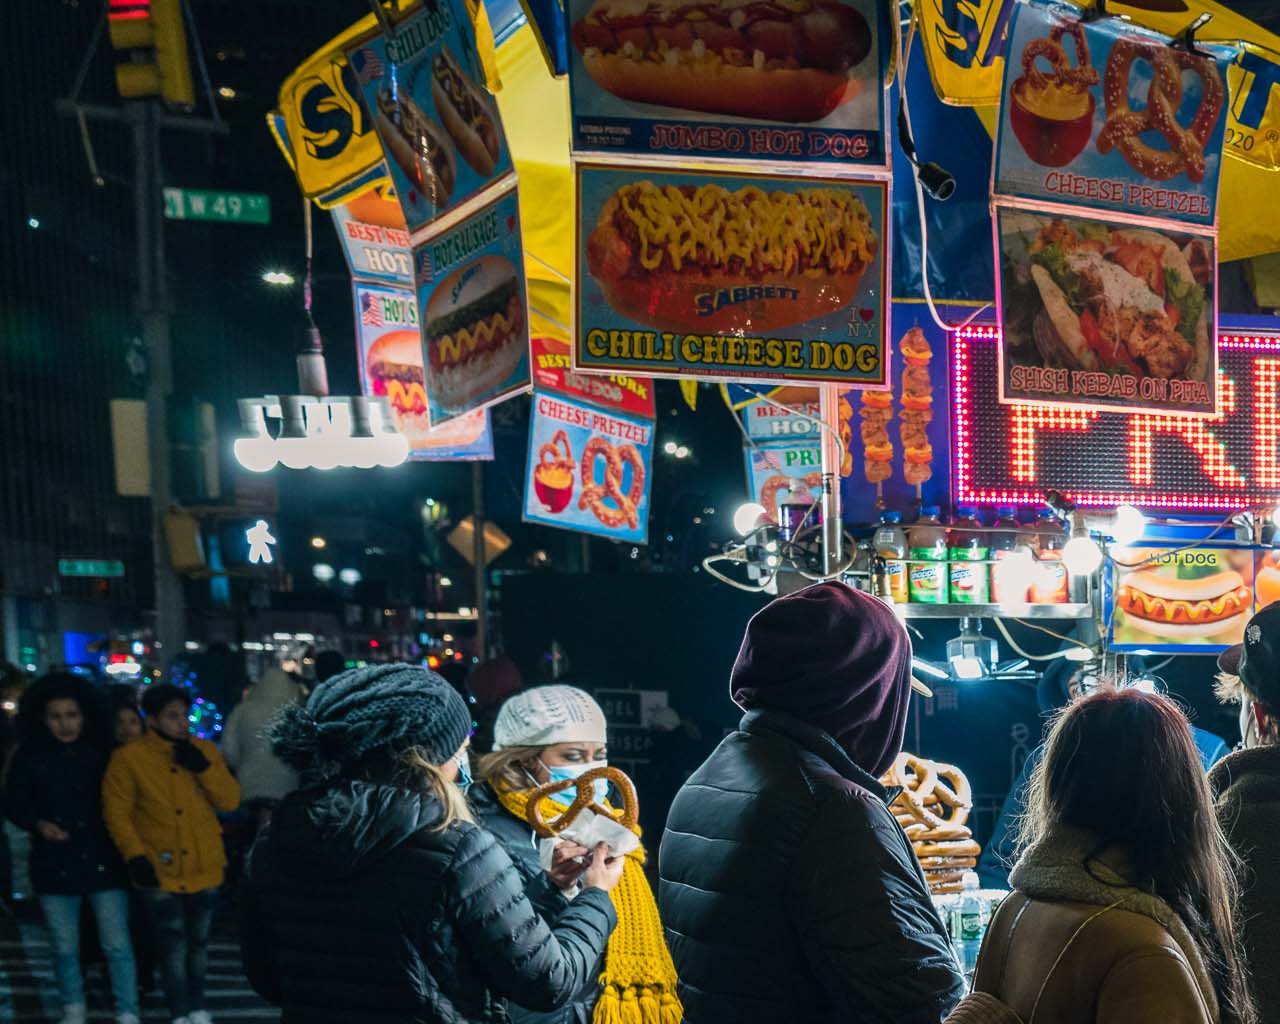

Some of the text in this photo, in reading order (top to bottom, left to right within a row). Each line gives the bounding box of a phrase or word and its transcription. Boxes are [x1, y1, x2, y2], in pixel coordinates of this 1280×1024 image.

[650, 124, 745, 151] JUMBO
[750, 126, 804, 154] HOT
[809, 129, 870, 158] DOG
[189, 194, 206, 214] W
[213, 196, 241, 217] 49
[1044, 171, 1211, 216] CHEESE PRETZEL
[346, 221, 382, 244] BEST
[365, 248, 408, 276] HOT
[383, 297, 409, 324] HOT
[694, 284, 801, 318] SABRETT
[849, 307, 858, 323] I
[848, 322, 876, 338] NY
[537, 354, 571, 369] BEST
[586, 329, 879, 373] CHILI CHEESE DOG
[1011, 366, 1212, 404] SHISH KEBAB ON PITA
[538, 398, 648, 445] CHEESE PRETZEL
[1150, 552, 1217, 567] HOT DOG
